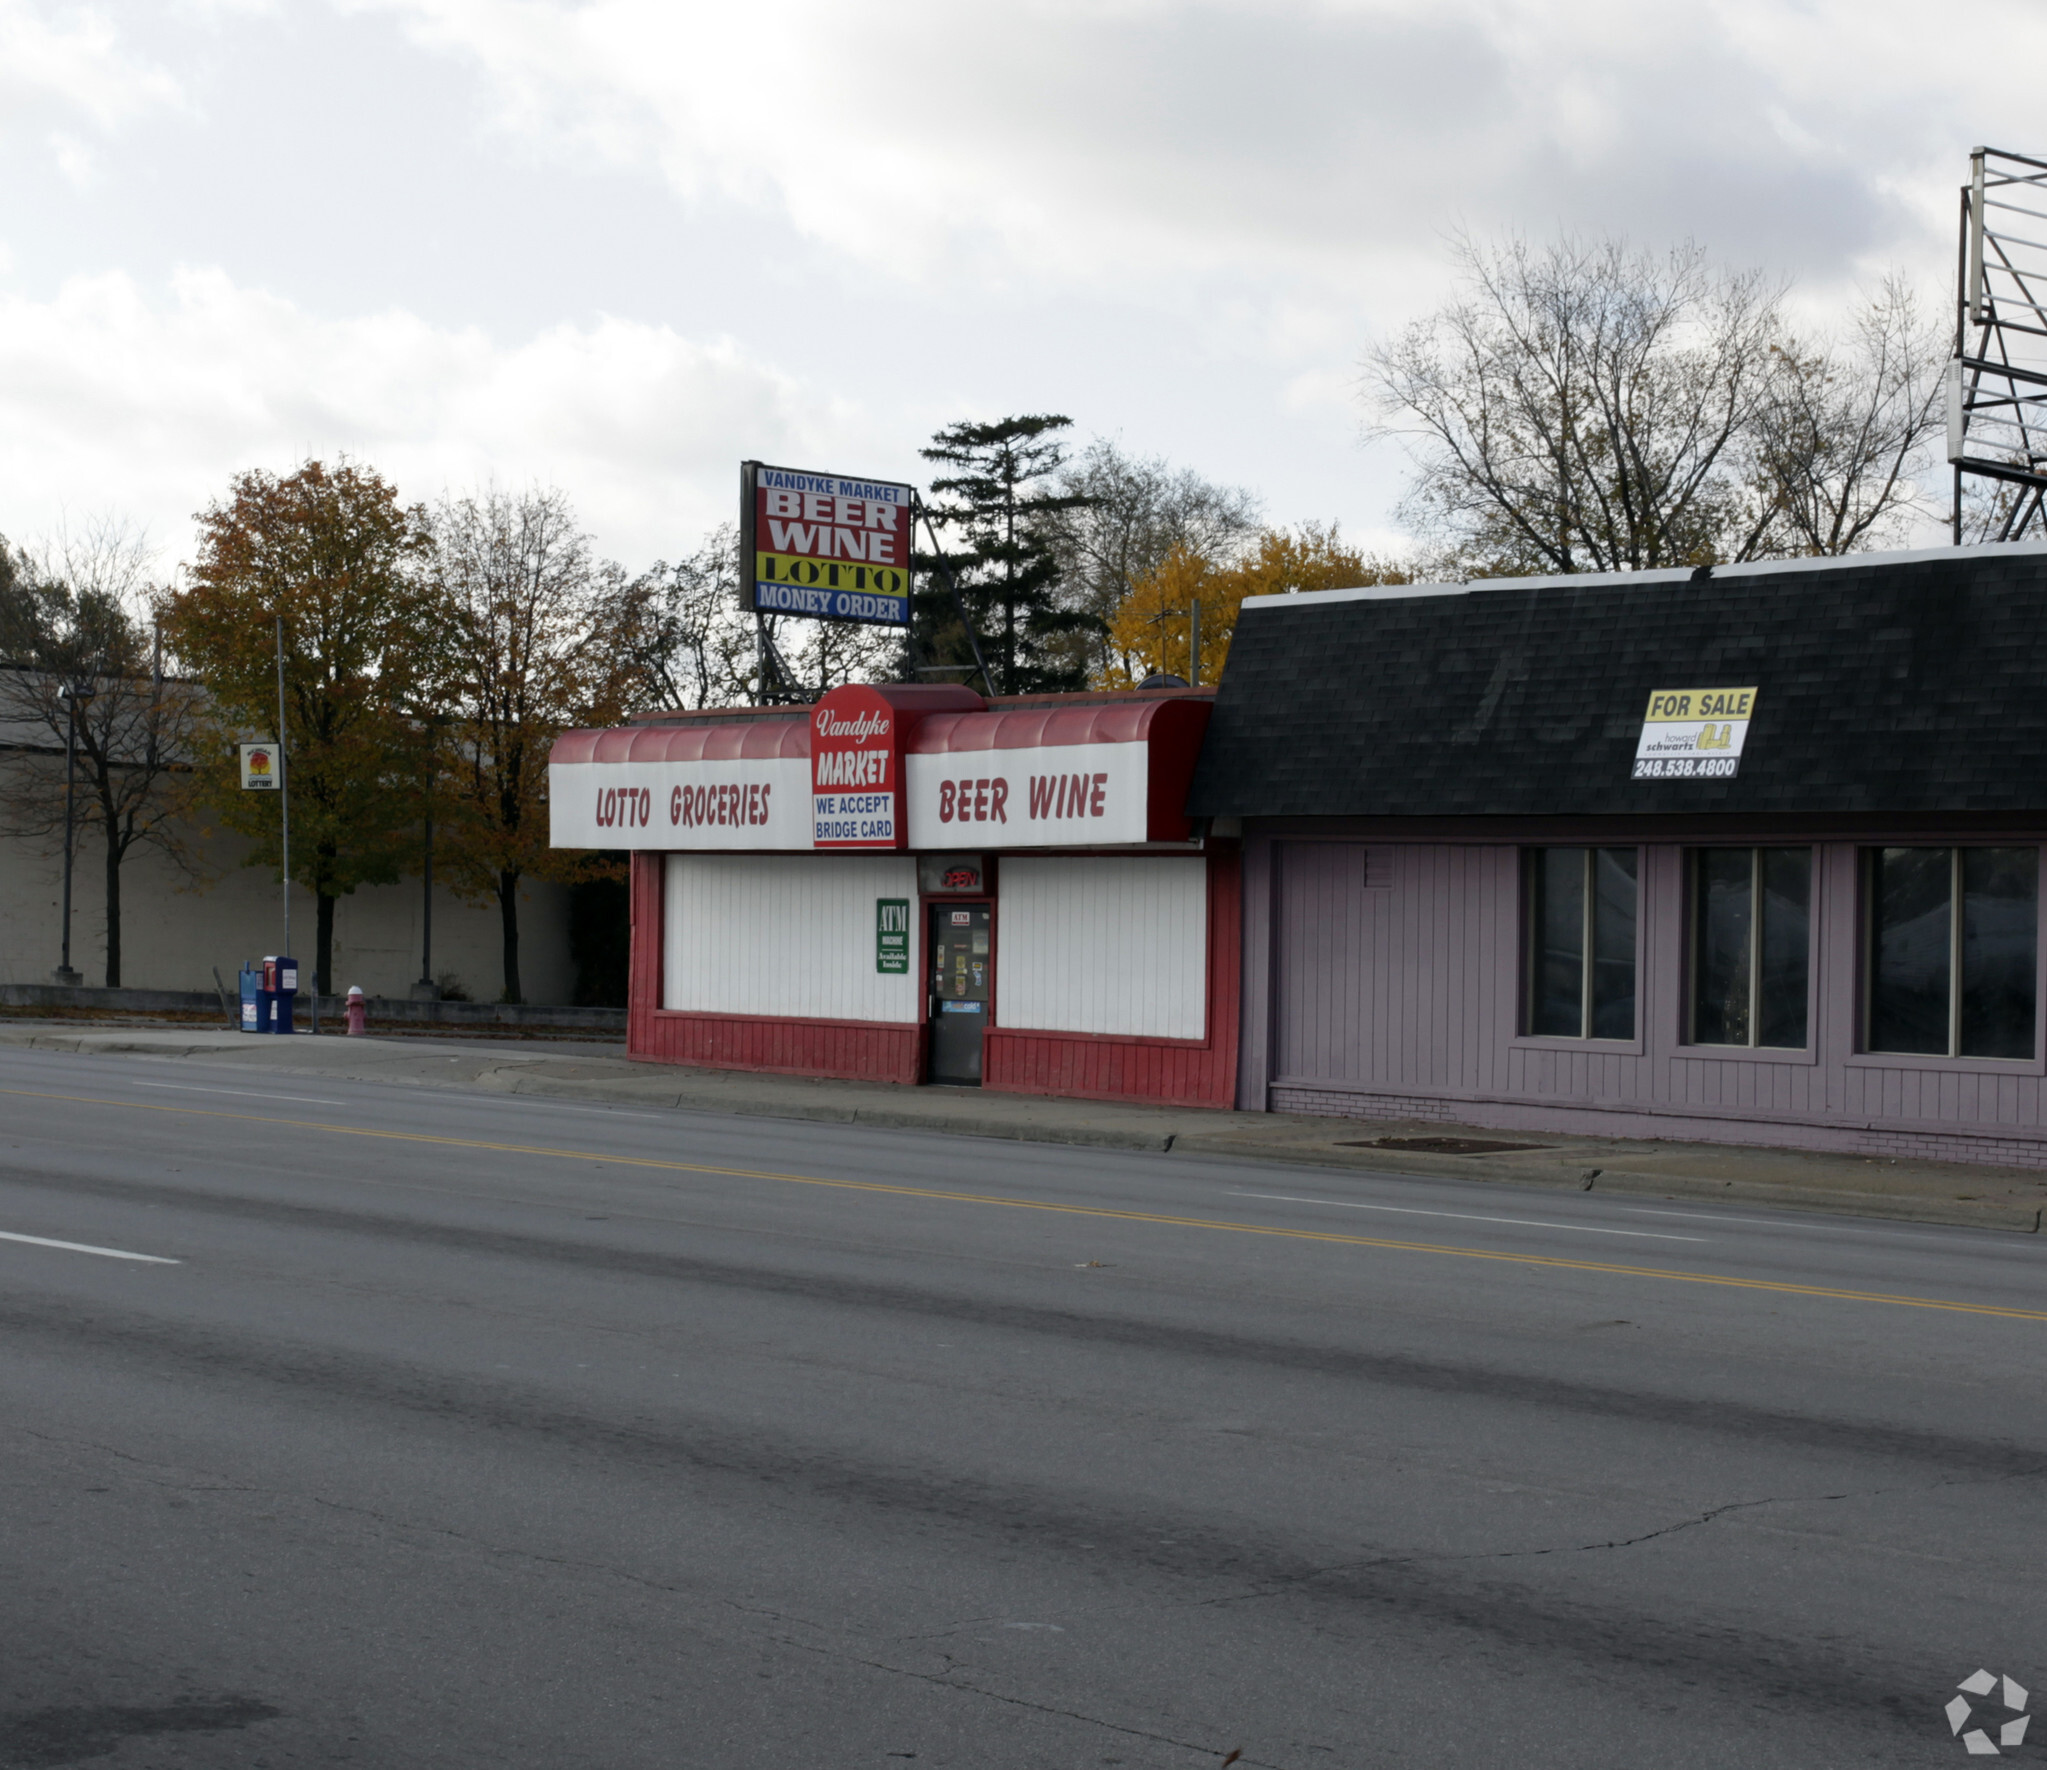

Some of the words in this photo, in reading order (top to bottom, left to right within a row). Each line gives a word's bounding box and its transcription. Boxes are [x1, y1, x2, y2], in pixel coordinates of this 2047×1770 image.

[764, 470, 834, 495] VANDYKE
[839, 481, 900, 503] MARKET
[766, 488, 898, 531] BEER
[767, 519, 896, 564] WINE
[765, 556, 901, 593] LOTTO
[759, 585, 832, 613] MONEY
[836, 593, 901, 621] ORDER
[1650, 695, 1691, 717] FOR
[1698, 693, 1751, 716] SALE
[816, 709, 890, 744] Vandyke
[1664, 732, 1698, 743] howard
[1646, 741, 1694, 751] schwartz
[816, 749, 889, 787] MARKET
[1634, 758, 1736, 777] 248.538.4800
[596, 787, 651, 828] LOTTO
[670, 783, 771, 829] GROCERIES
[816, 797, 835, 815] WE
[838, 795, 890, 814] ACCEPT
[938, 777, 1009, 825] BEER
[1029, 772, 1108, 820] WINE
[816, 820, 858, 839] BRIDGE
[860, 819, 893, 837] CARD
[943, 872, 977, 887] OPEN
[878, 905, 907, 932] ATM
[878, 952, 907, 961] Available
[882, 960, 902, 969] Inside
